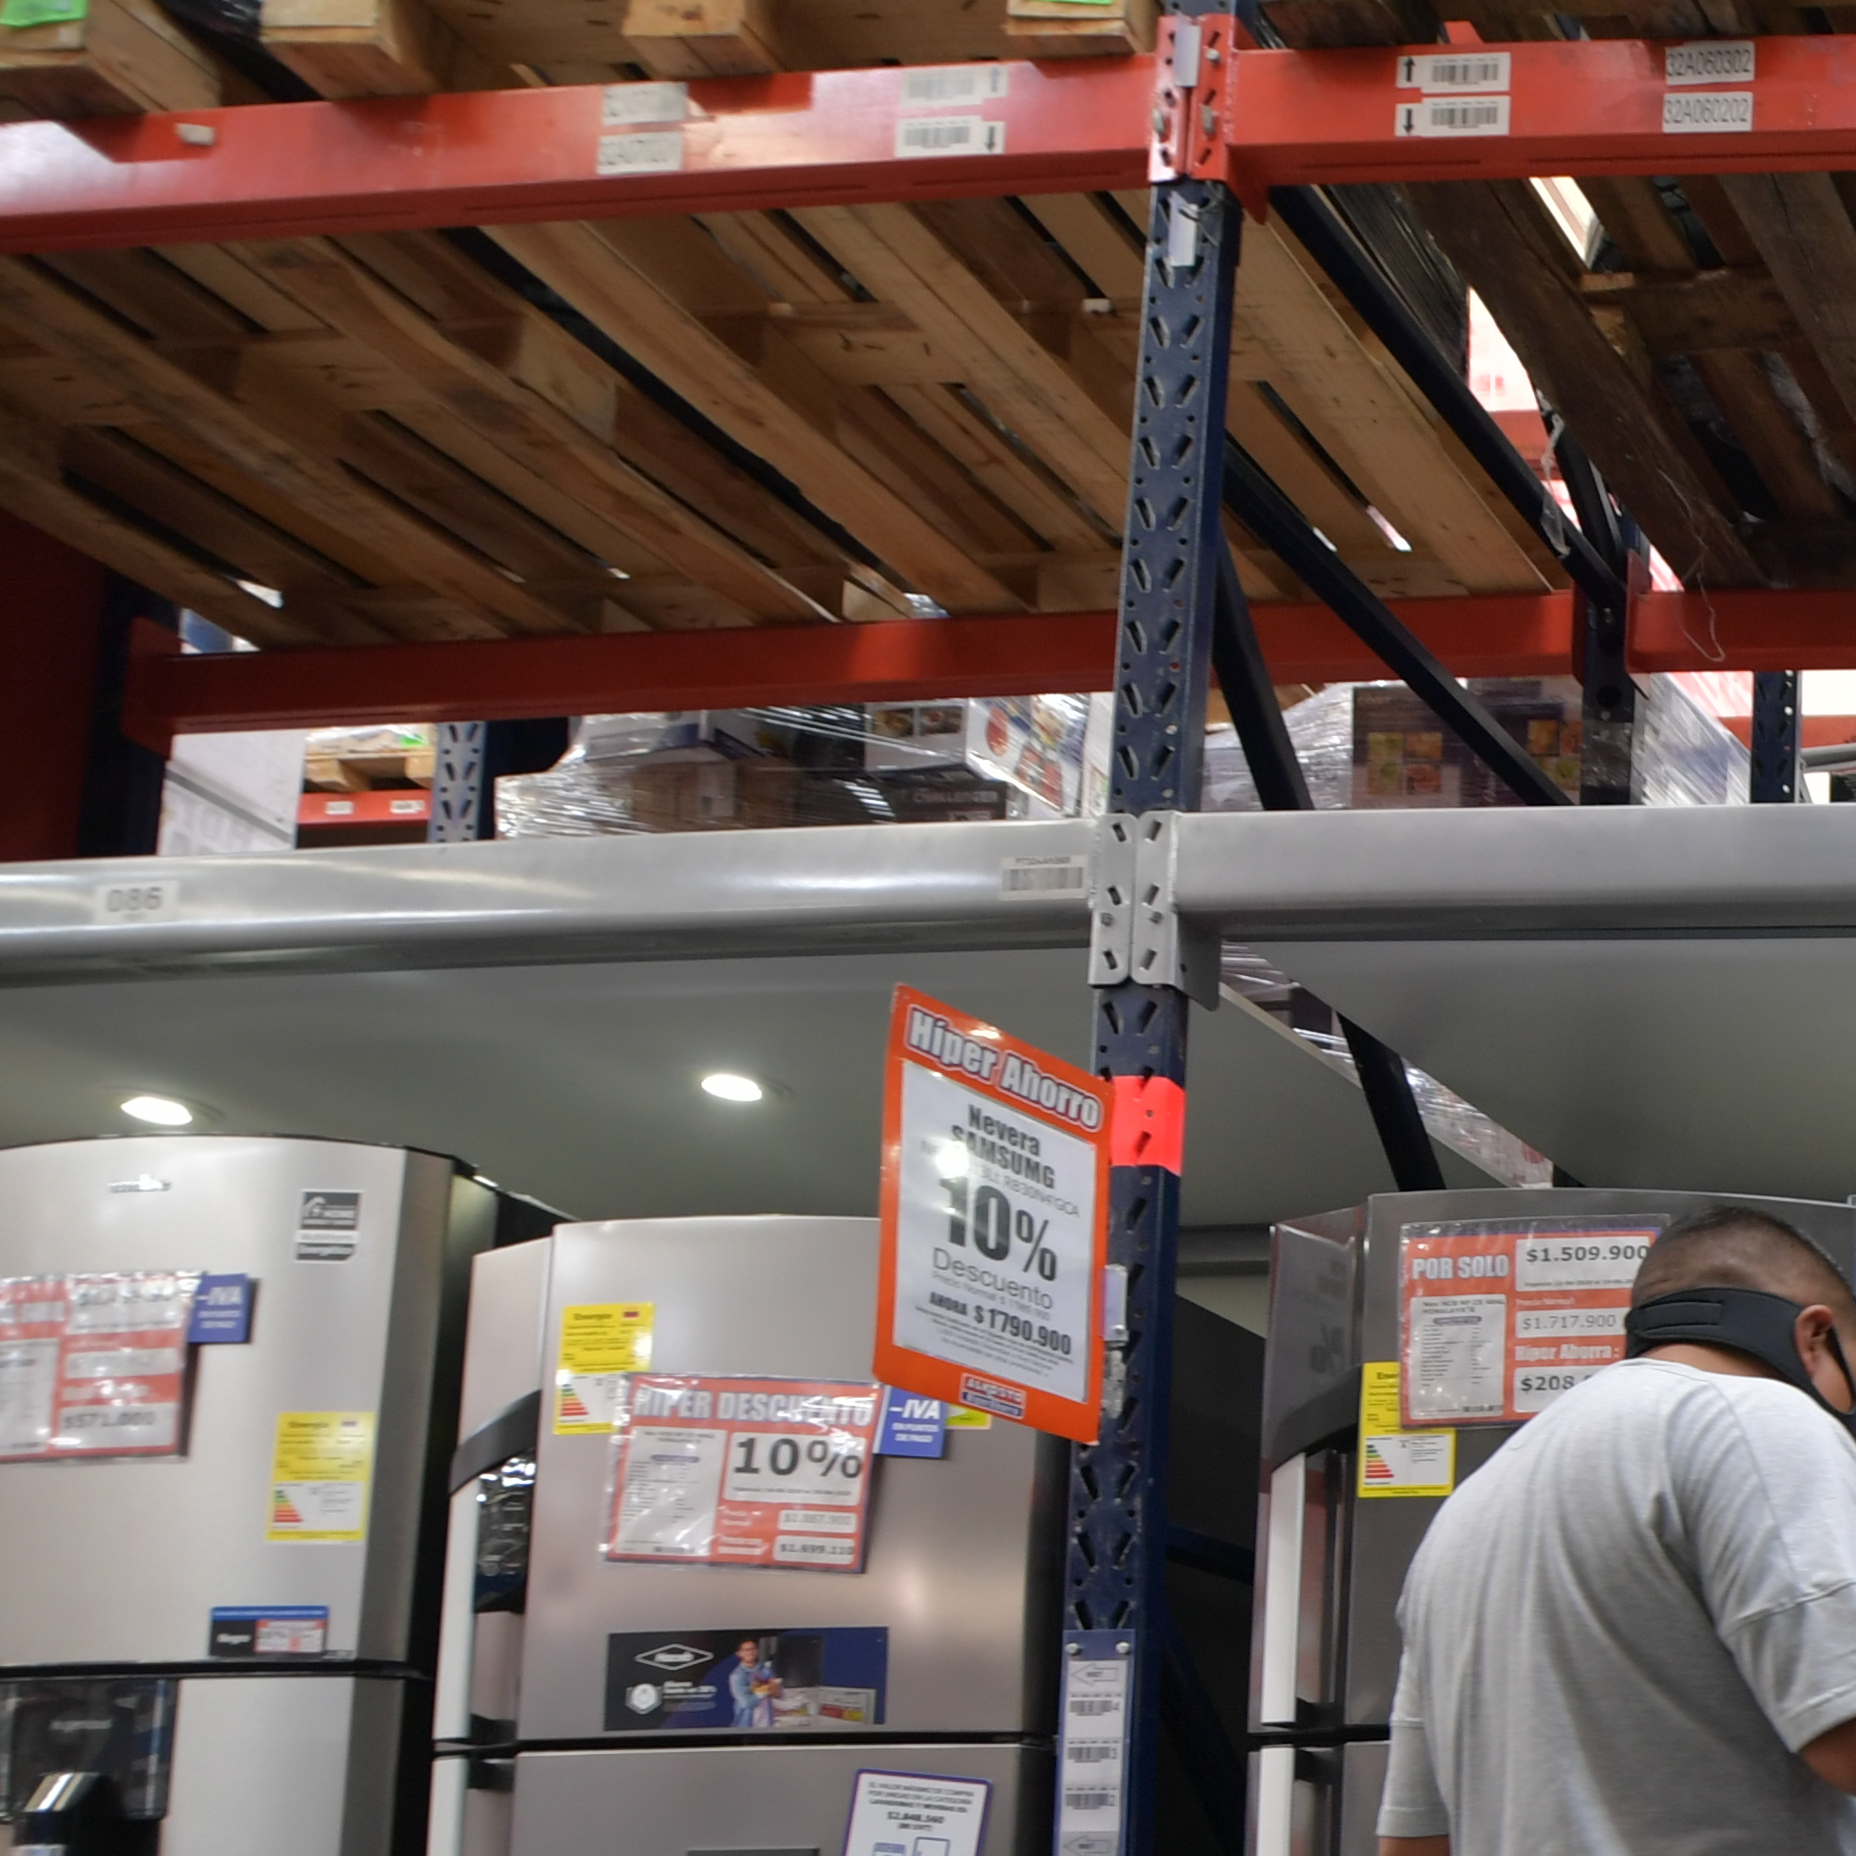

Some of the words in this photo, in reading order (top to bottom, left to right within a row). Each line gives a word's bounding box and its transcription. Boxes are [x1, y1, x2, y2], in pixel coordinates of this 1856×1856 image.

[1667, 50, 1752, 78] 32A060302
[1663, 97, 1749, 125] 32A060202
[106, 887, 162, 912] 086
[1001, 1054, 1101, 1127] Ahorro
[968, 1105, 1040, 1156] Nevera
[939, 1176, 1058, 1283] 10%
[933, 1248, 1053, 1309] Descuento
[1412, 1258, 1454, 1280] POR
[1458, 1255, 1509, 1279] SOLO
[1526, 1245, 1650, 1263] $1.509.900
[1522, 1314, 1616, 1331] $1.717.900
[633, 1388, 712, 1419] HIPER
[717, 1391, 875, 1426] DESCUENTO
[889, 1398, 942, 1421] -IVA
[732, 1437, 863, 1480] 10%
